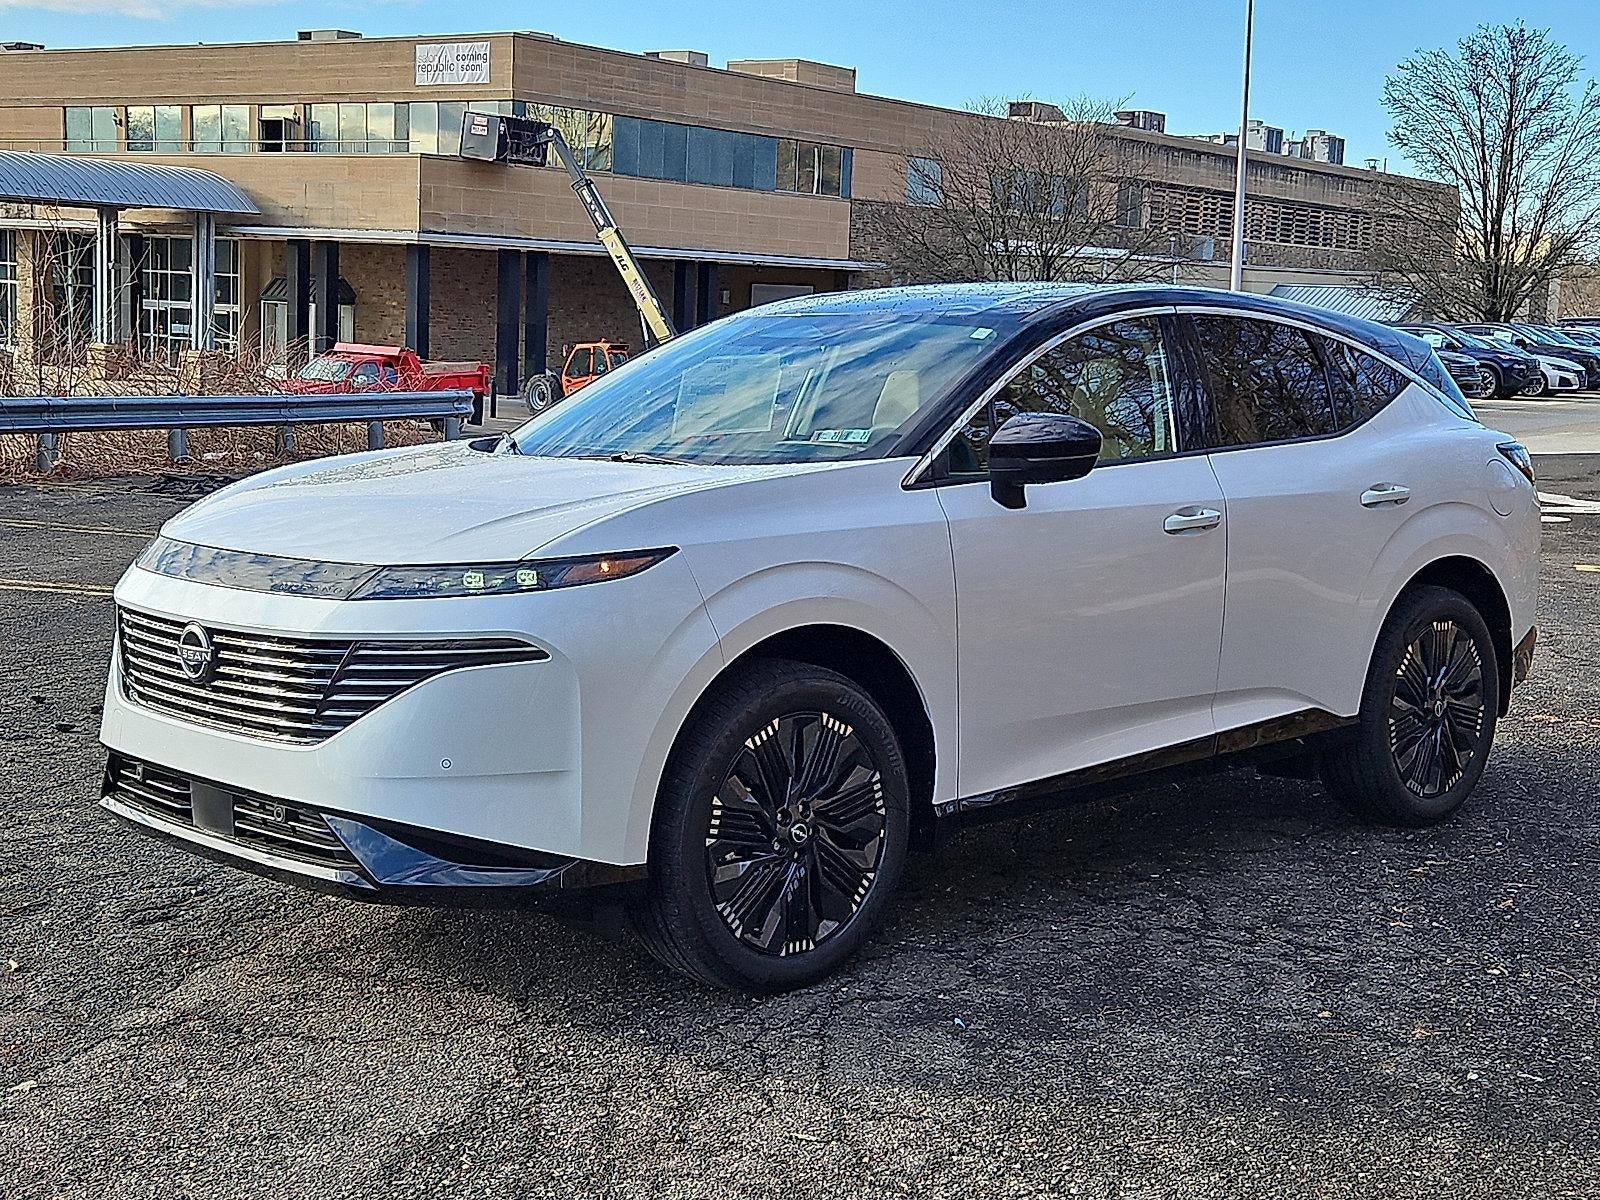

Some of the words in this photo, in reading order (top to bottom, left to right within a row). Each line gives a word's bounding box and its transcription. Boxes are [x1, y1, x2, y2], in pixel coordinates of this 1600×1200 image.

[456, 51, 488, 64] coming
[417, 55, 455, 80] republic
[461, 63, 483, 72] soon!
[615, 254, 630, 271] JLG
